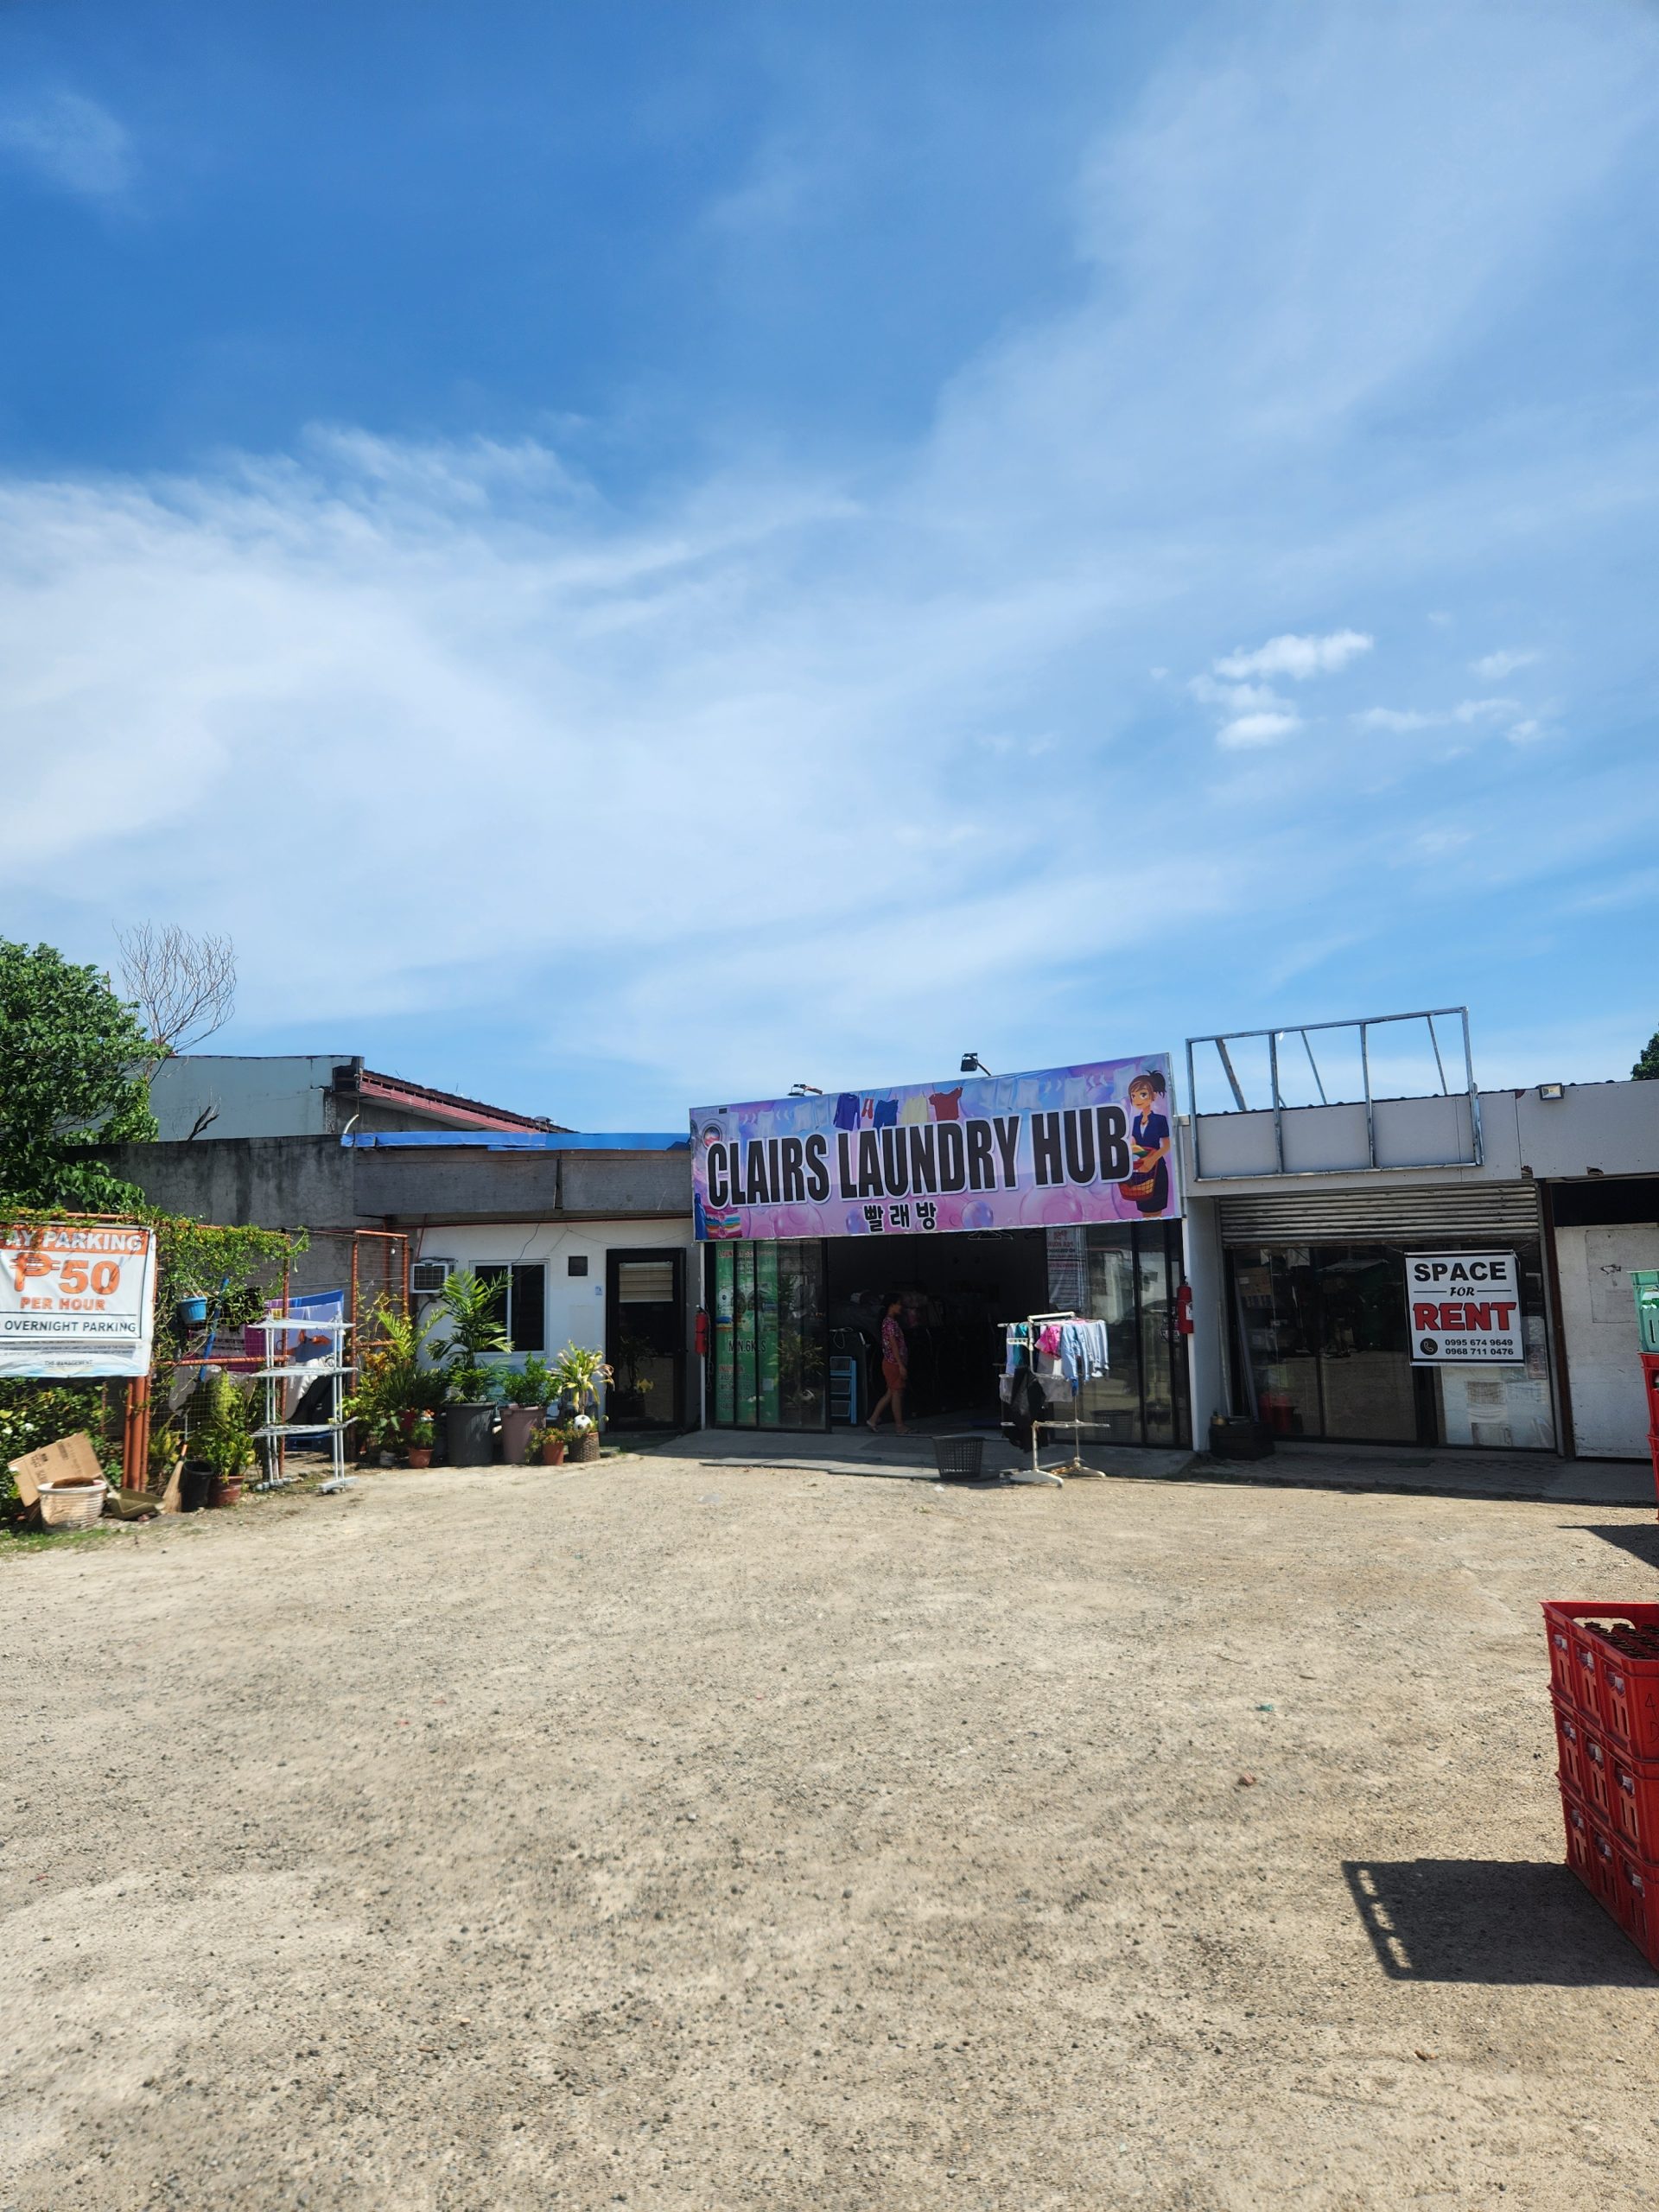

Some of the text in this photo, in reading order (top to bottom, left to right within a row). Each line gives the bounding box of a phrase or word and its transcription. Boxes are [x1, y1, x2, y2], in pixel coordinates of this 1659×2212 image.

[708, 1106, 1131, 1207] CLAIRS LAUNDRY HUB
[864, 1202, 937, 1232] 빨래방
[0, 1229, 143, 1251] AY PARKING
[1414, 1262, 1507, 1281] SPACE
[1450, 1287, 1475, 1297] FOR
[20, 1297, 105, 1311] PER HOUR
[4, 1320, 136, 1332] OVERNIGHT PARKING
[1413, 1302, 1516, 1331] RENT
